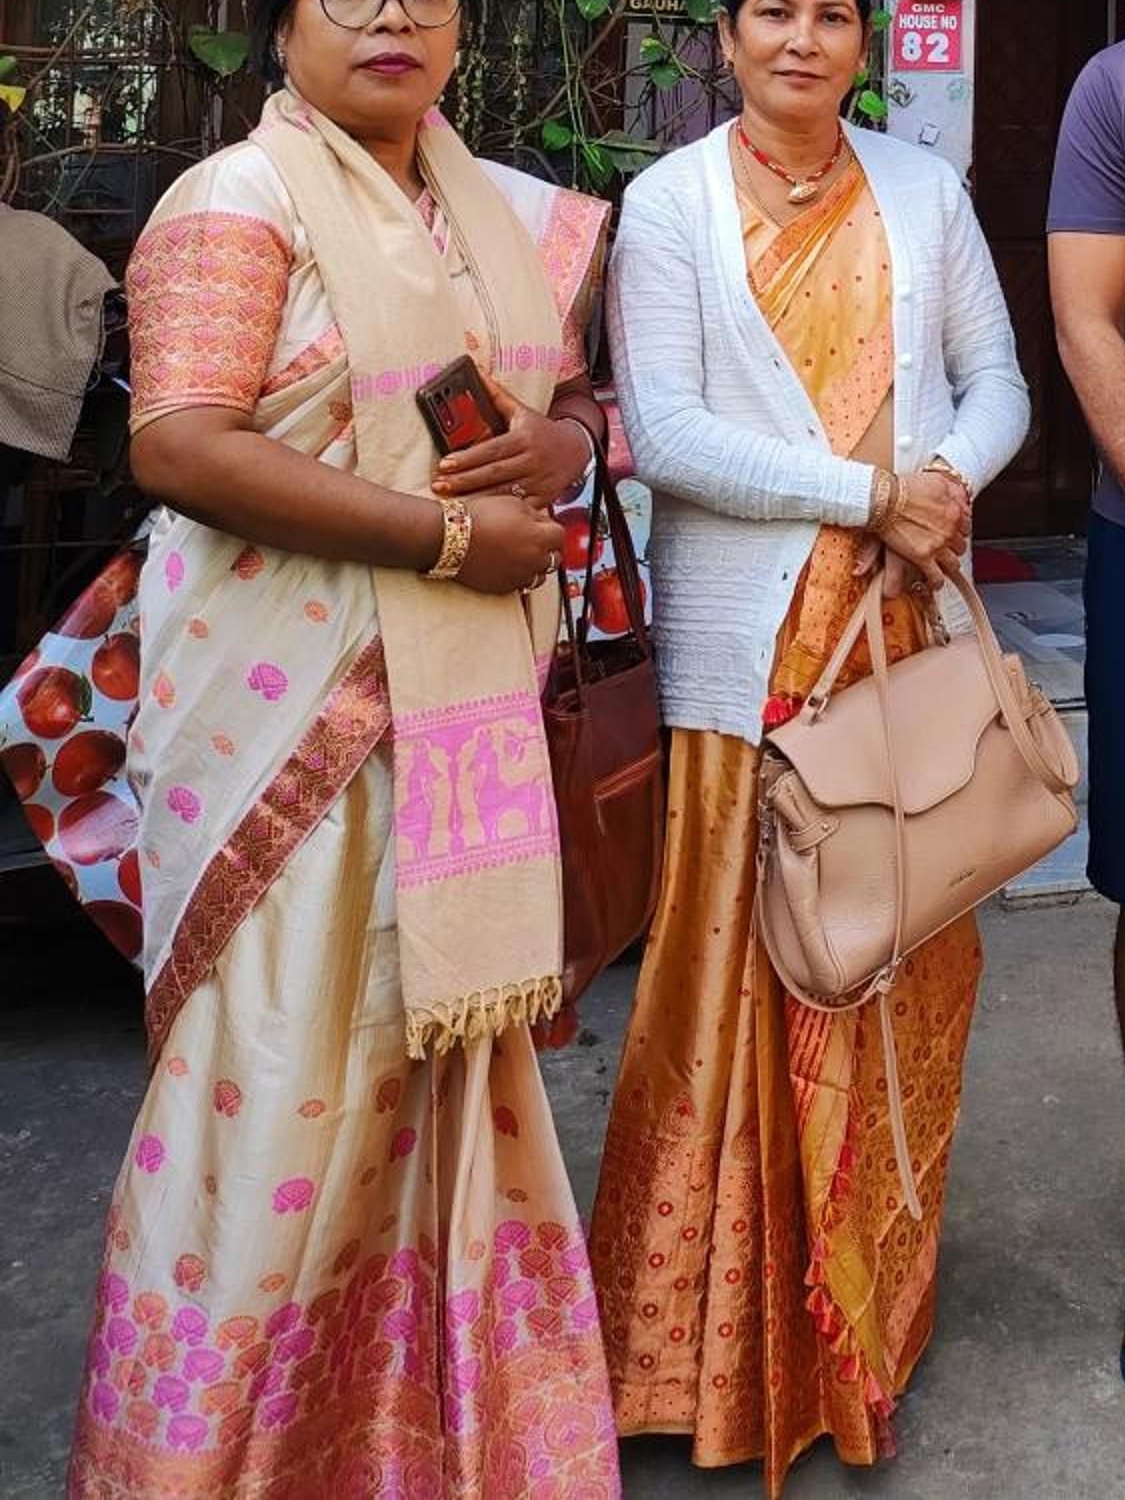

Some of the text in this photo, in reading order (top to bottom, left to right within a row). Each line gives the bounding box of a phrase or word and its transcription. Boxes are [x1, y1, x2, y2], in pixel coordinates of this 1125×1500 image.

[911, 3, 945, 13] GMC
[899, 14, 957, 30] HOUSE NO
[901, 30, 950, 63] 82
